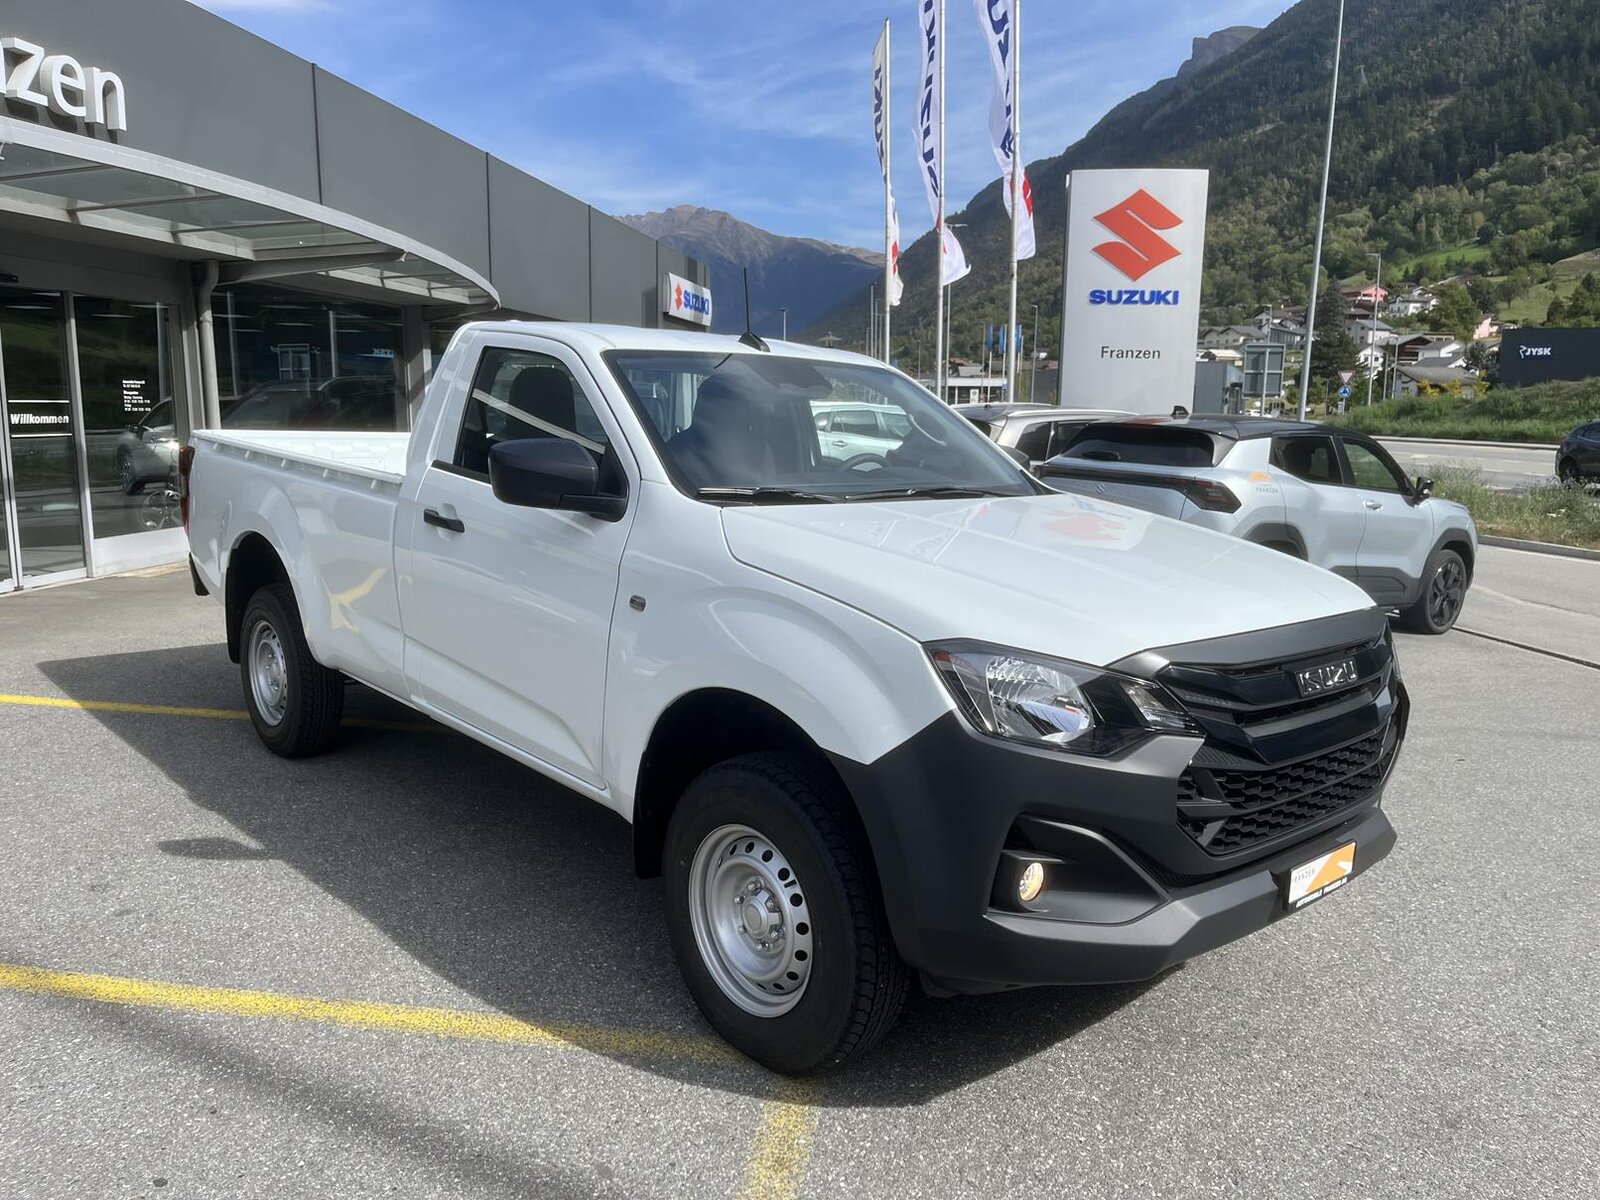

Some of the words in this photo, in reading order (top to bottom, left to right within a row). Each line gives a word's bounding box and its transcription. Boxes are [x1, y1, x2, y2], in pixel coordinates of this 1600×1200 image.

[0, 37, 127, 131] zen
[683, 290, 709, 315] SUZUKI
[1088, 289, 1180, 305] SUZUKI
[1100, 345, 1161, 360] Franzen
[1525, 347, 1552, 356] JYSK
[10, 413, 69, 425] Willkommen
[1299, 660, 1358, 695] ISUZU
